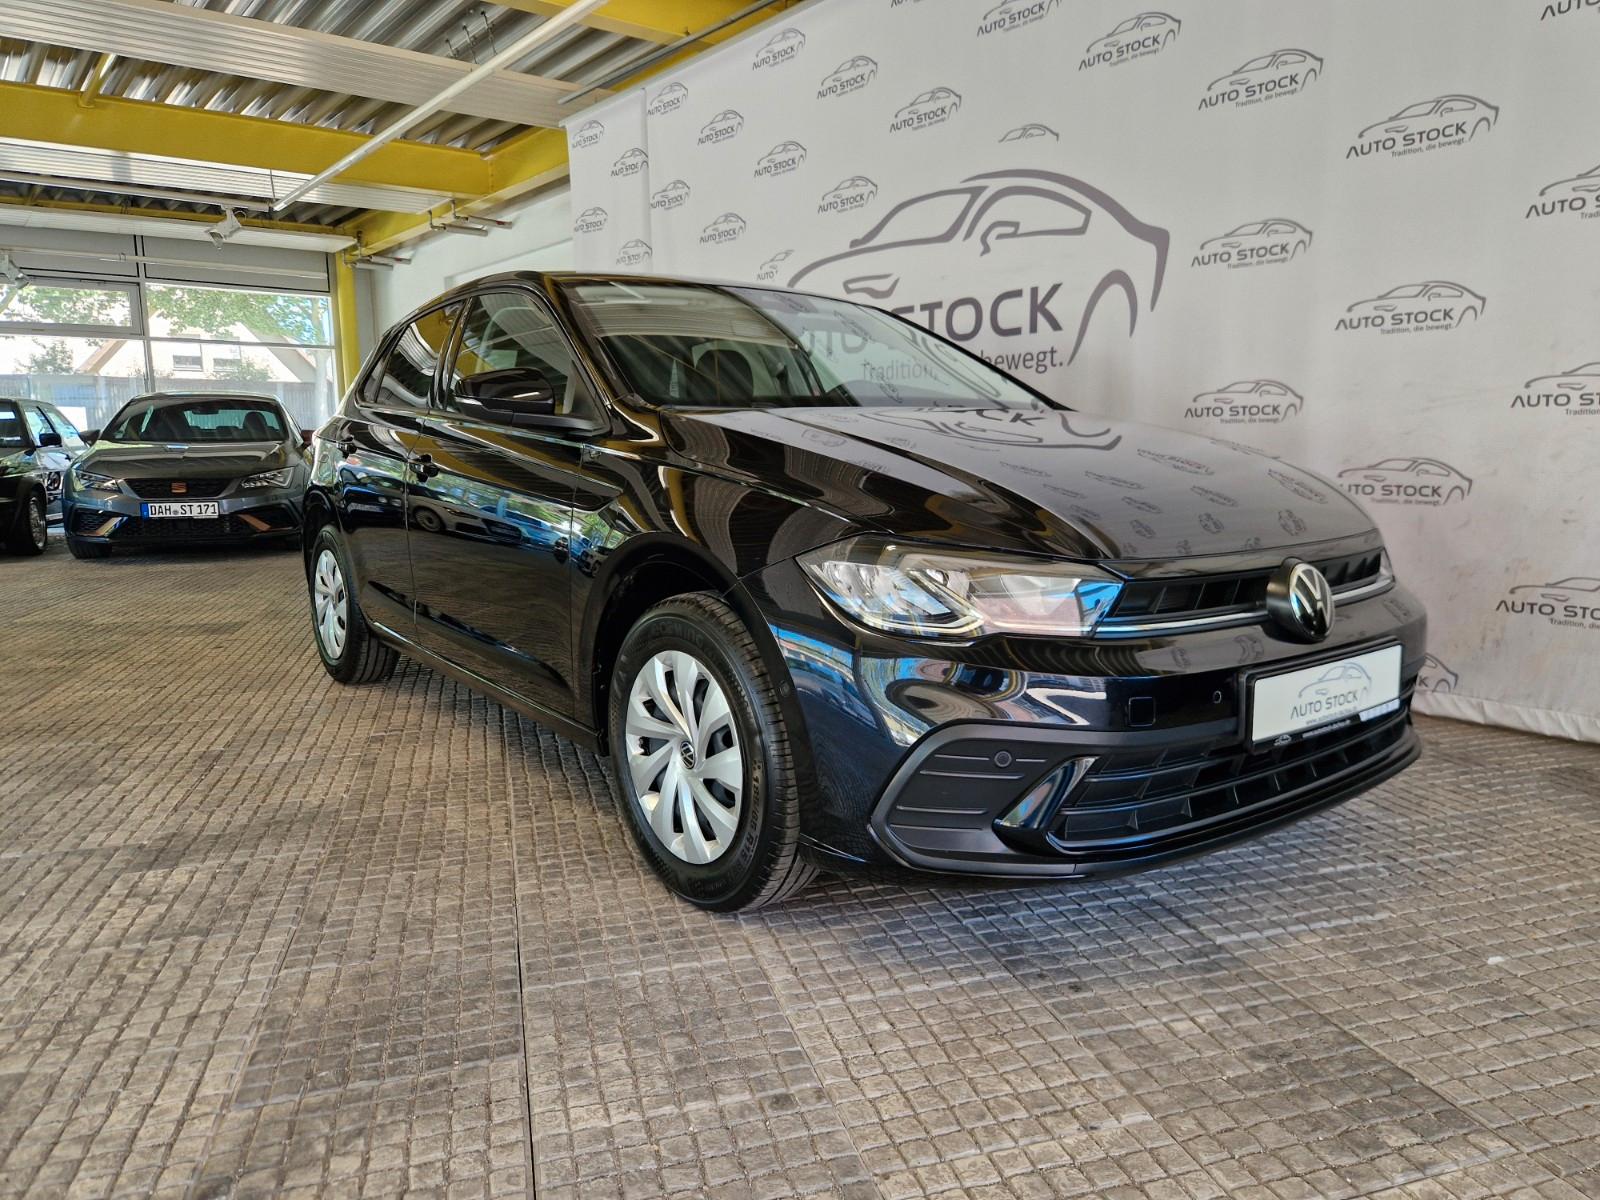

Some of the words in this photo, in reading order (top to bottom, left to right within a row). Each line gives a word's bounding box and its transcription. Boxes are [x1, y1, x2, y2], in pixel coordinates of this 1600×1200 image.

[977, 18, 1006, 37] AUTO
[1009, 1, 1045, 24] STOCK
[1541, 0, 1600, 21] AU
[752, 55, 771, 71] AUTO
[772, 45, 795, 62] STOCK
[1079, 50, 1113, 71] AUTO
[1116, 34, 1160, 58] STOCK
[816, 84, 838, 99] AUTO
[840, 73, 866, 91] STOCK
[1198, 89, 1239, 110] AUTO
[1245, 73, 1299, 98] STOCK
[663, 96, 681, 110] STOCK
[889, 117, 914, 133] AUTO
[916, 106, 947, 124] STOCK
[697, 133, 714, 146] AUTO
[714, 125, 735, 139] STOCK
[1346, 137, 1396, 159] AUTO
[1402, 121, 1466, 147] STOCK
[1425, 143, 1437, 151] die
[625, 162, 640, 173] STOC
[754, 165, 772, 178] AUTO
[773, 157, 796, 172] STOCK
[818, 200, 839, 214] AUTO
[840, 193, 865, 208] STOCK
[1526, 197, 1586, 219] AUTO
[700, 233, 717, 244] AUTO
[718, 228, 737, 239] STOCK
[1191, 251, 1232, 267] AUTO
[1237, 242, 1290, 261] STOCK
[757, 271, 774, 281] AUTO
[891, 283, 1063, 342] TOCK
[1335, 315, 1385, 331] AUTO
[1391, 308, 1455, 326] STOCK
[1510, 393, 1571, 408] AUTO
[1184, 406, 1224, 419] AUTO
[1229, 404, 1281, 417] STOCK
[1348, 483, 1376, 496] TO
[1381, 484, 1443, 498] STOCK
[150, 504, 172, 516] DAH
[180, 504, 194, 515] ST
[196, 503, 217, 515] 171
[1495, 600, 1555, 616] AUTO
[1563, 604, 1600, 621] STO
[1290, 700, 1322, 720] AUTO
[1325, 689, 1359, 710] STOCK
